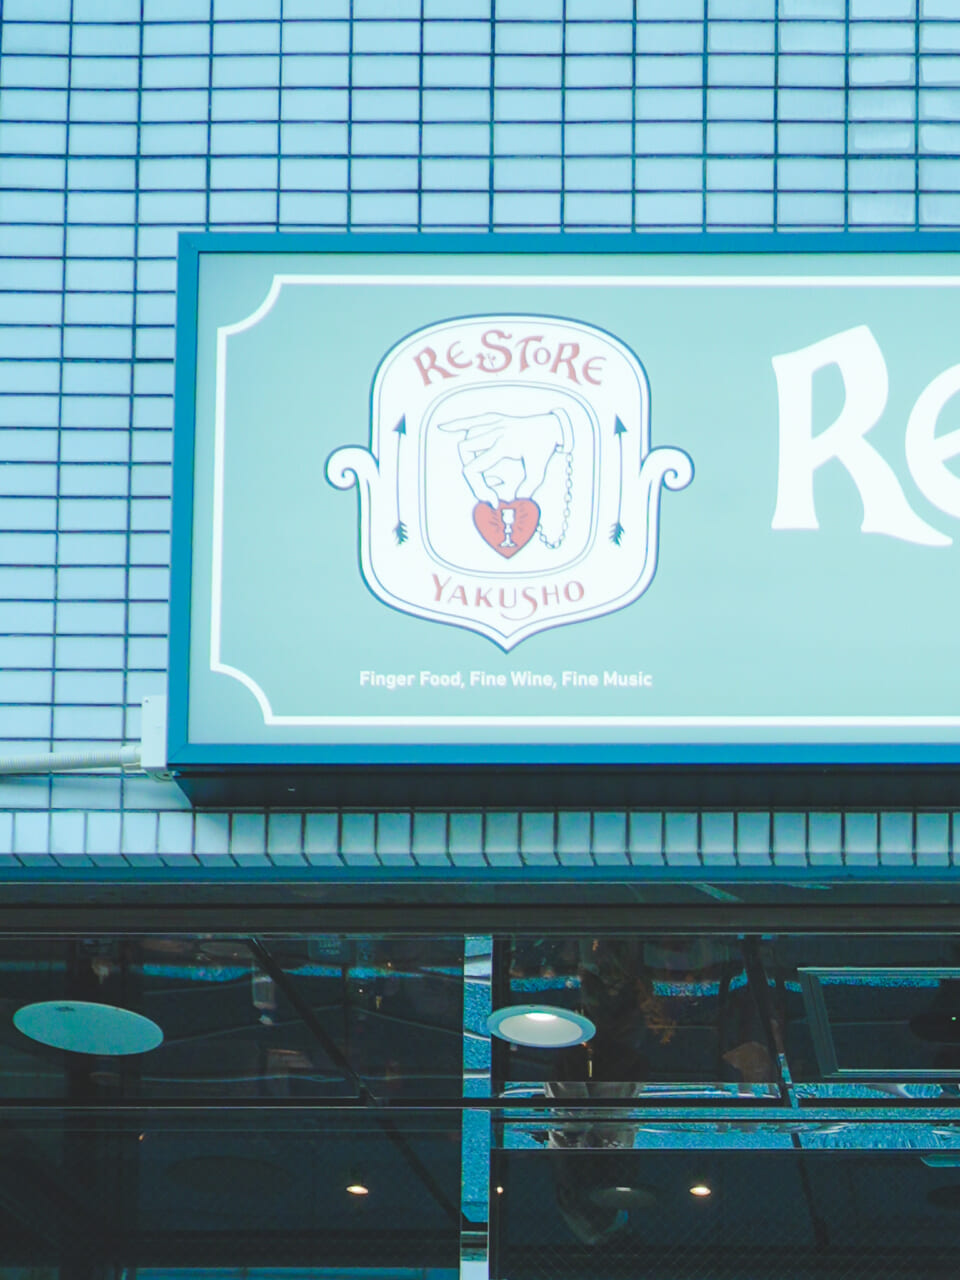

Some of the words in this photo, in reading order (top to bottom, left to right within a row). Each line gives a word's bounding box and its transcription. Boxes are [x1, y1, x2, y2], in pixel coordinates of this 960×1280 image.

[432, 573, 585, 621] YAKUSHO
[359, 670, 415, 689] Finger
[419, 670, 466, 689] Food,
[469, 670, 507, 687] Fine
[510, 670, 557, 689] Wine,
[561, 670, 599, 687] Fine
[602, 670, 653, 687] Music
